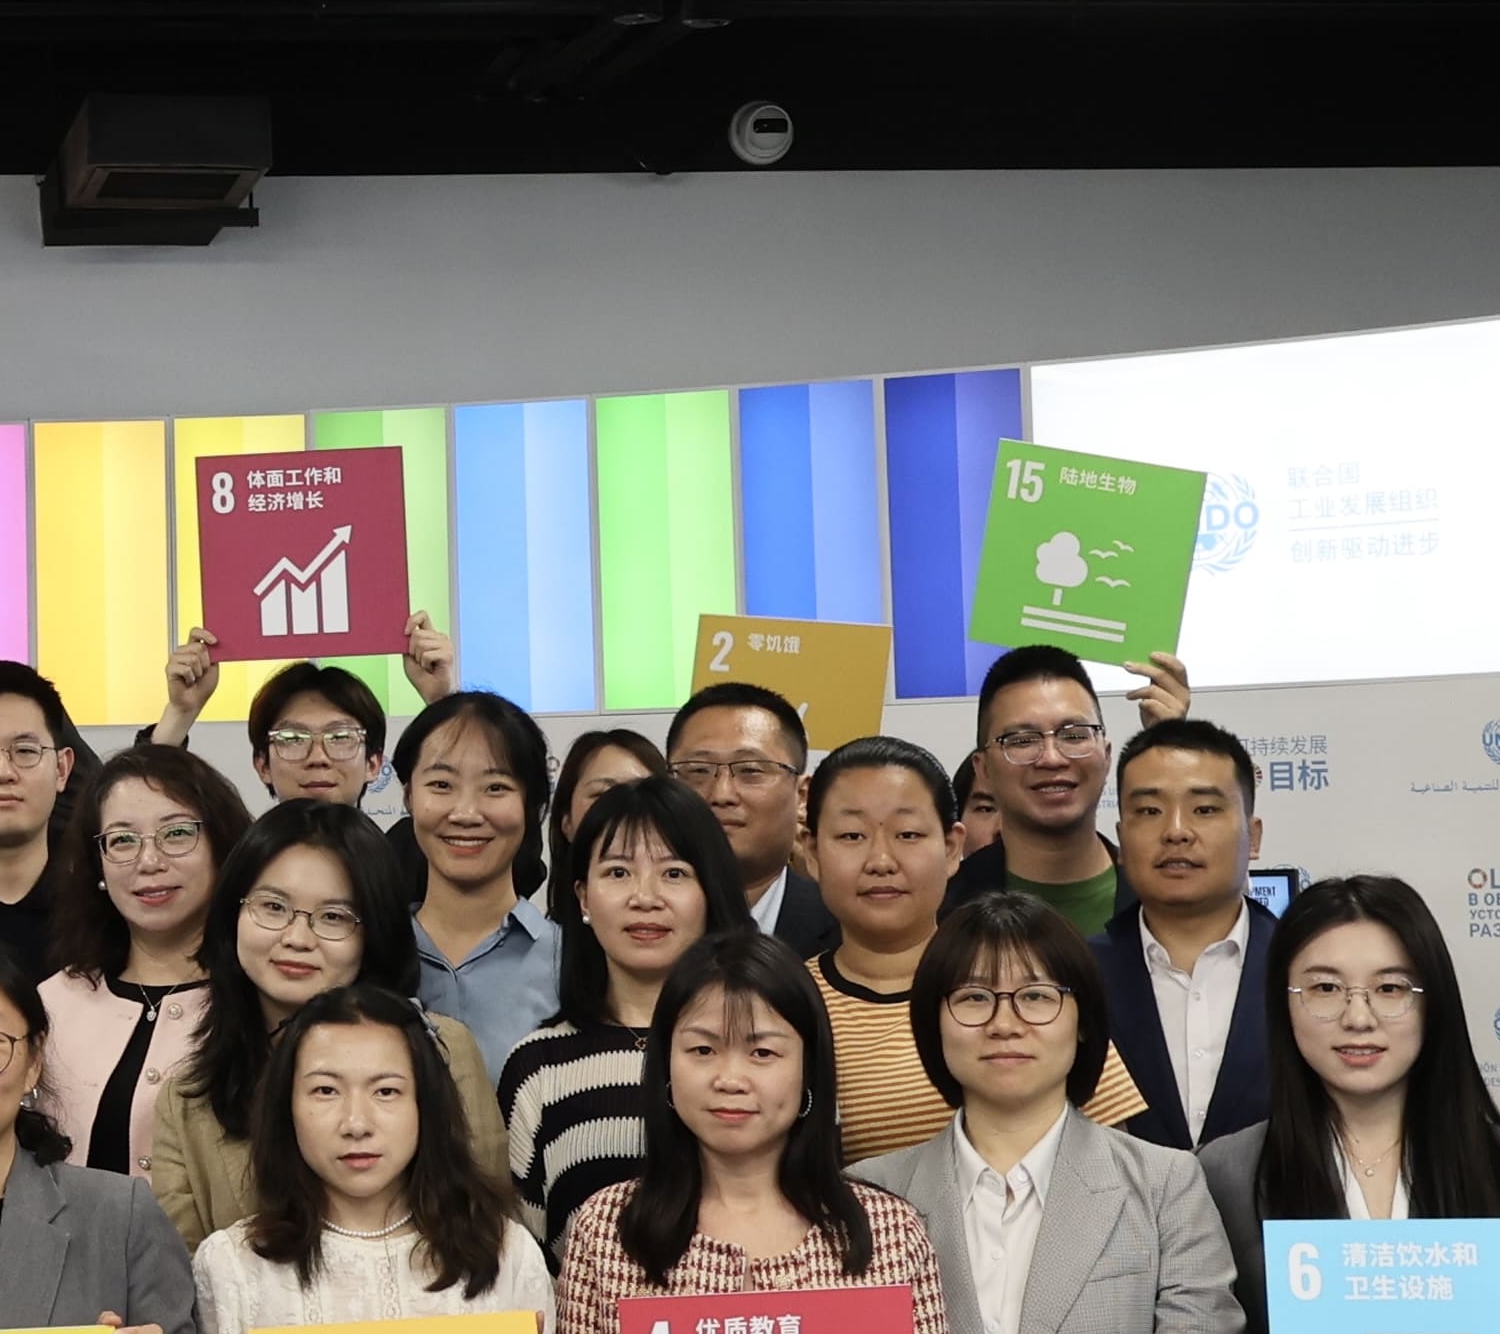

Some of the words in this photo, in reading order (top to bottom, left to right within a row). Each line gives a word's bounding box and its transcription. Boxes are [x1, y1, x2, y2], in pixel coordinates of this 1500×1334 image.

[247, 467, 341, 488] 体面工作和
[1007, 459, 1045, 502] 15
[1058, 467, 1137, 495] 陆地生物
[212, 472, 234, 513] 8
[248, 491, 323, 511] 经济增长
[710, 632, 733, 671] 2
[749, 634, 800, 653] 零饥饿
[1269, 760, 1329, 791] 目标
[1469, 893, 1478, 906] В
[1344, 1243, 1477, 1267] 清洁饮水和
[1289, 1243, 1321, 1300] 6
[1346, 1275, 1453, 1299] 卫生设施
